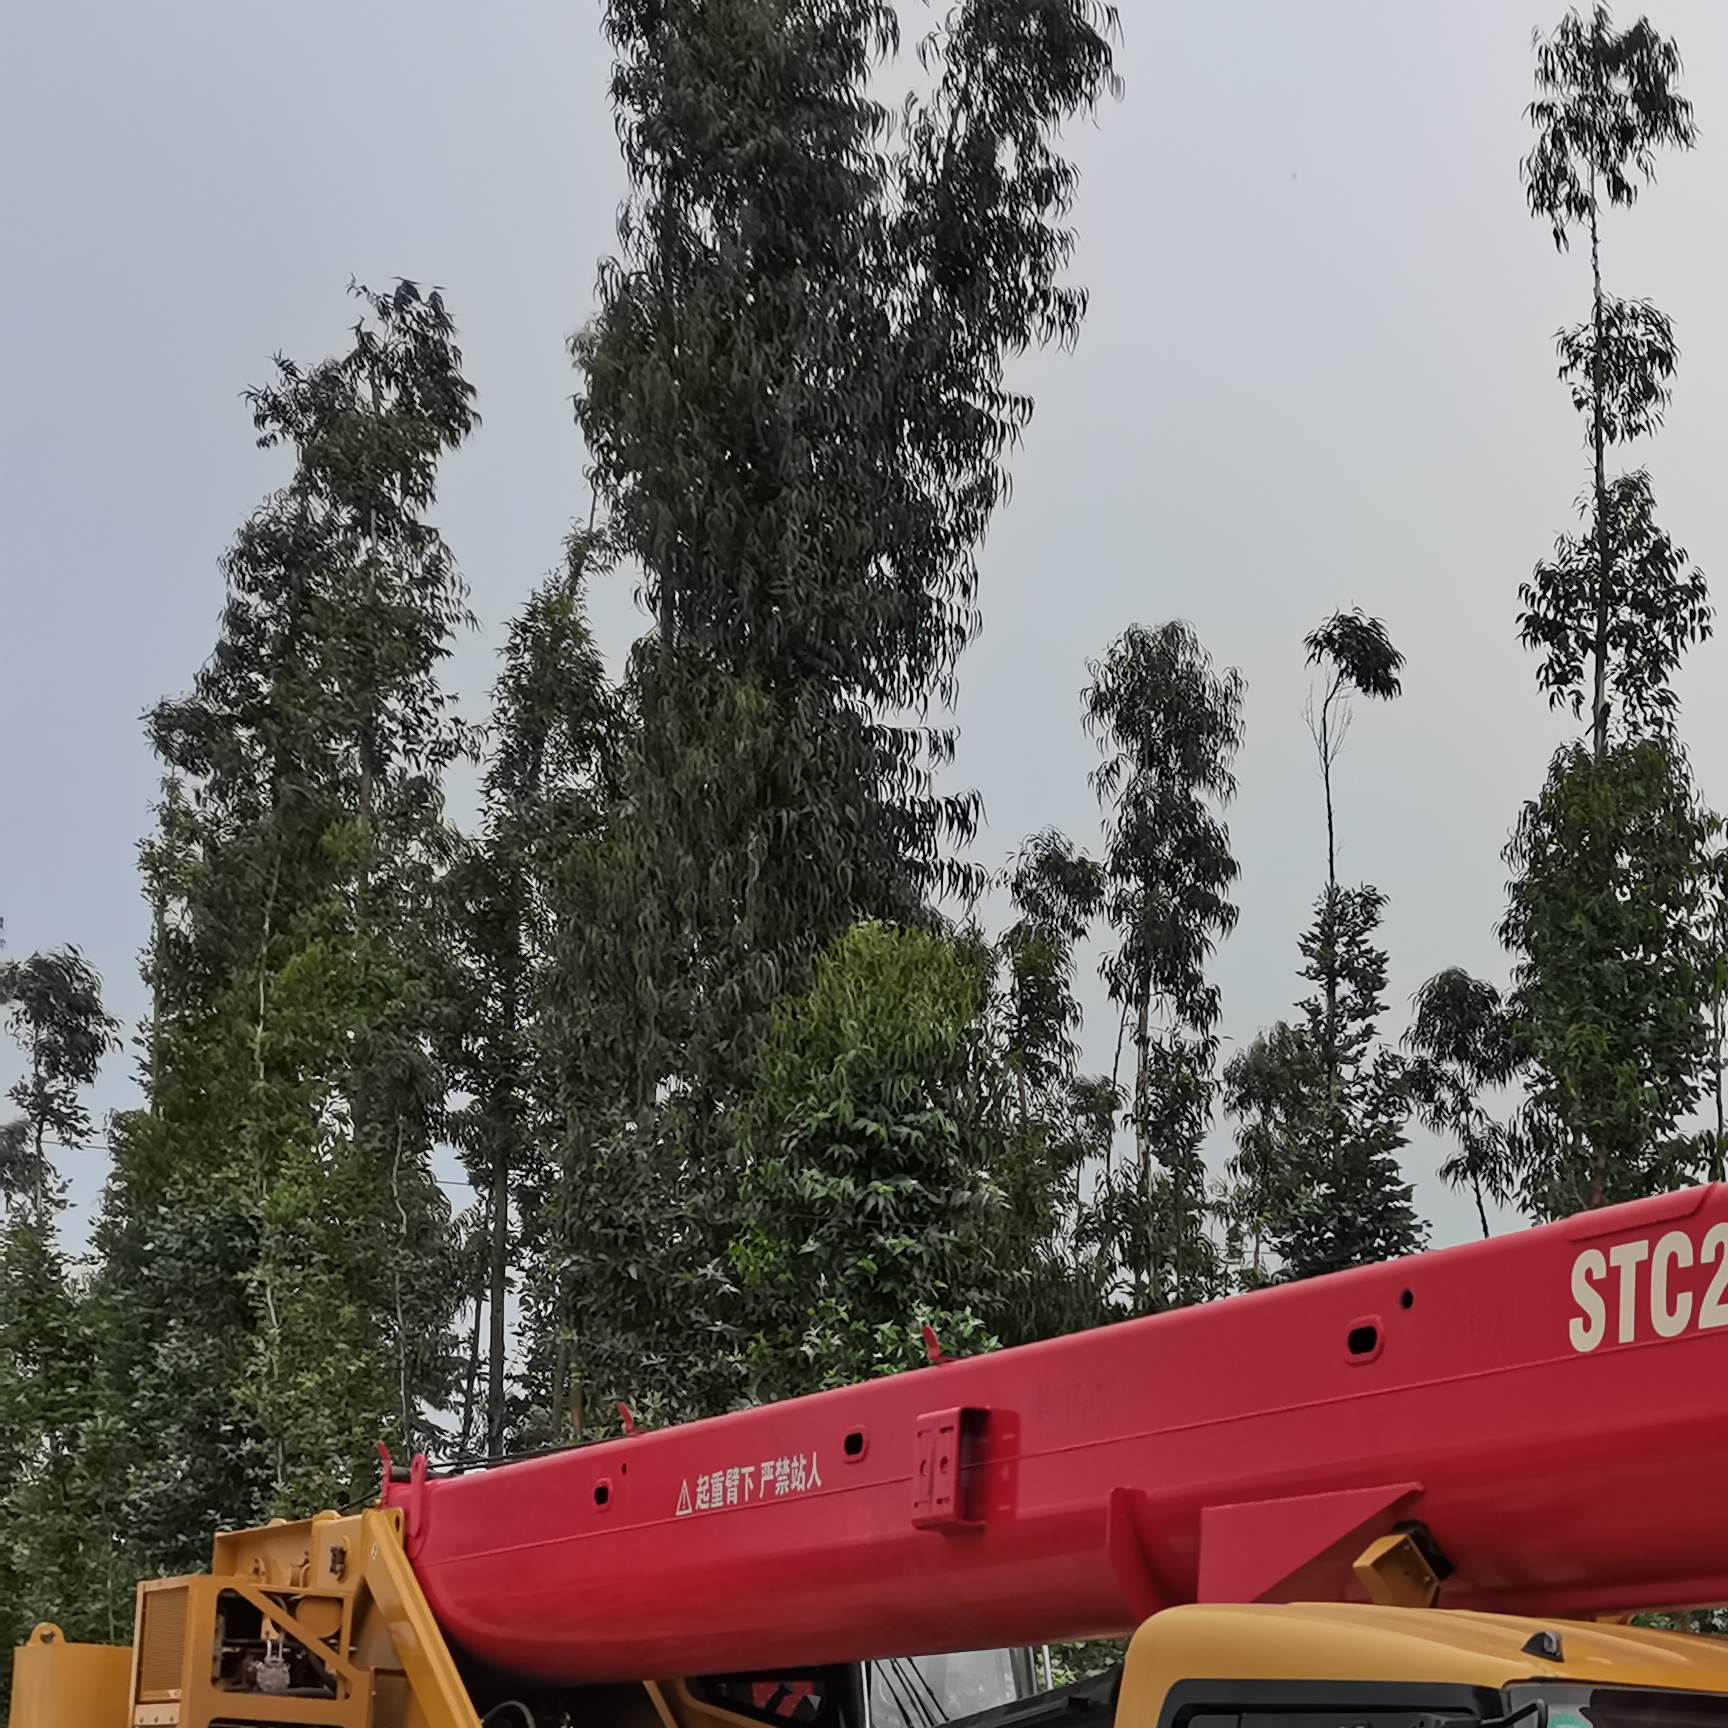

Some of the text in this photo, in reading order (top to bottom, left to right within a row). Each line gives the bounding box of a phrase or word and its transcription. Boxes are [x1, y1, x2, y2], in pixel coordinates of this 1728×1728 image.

[695, 1451, 822, 1510] 起重臂下 严禁站人
